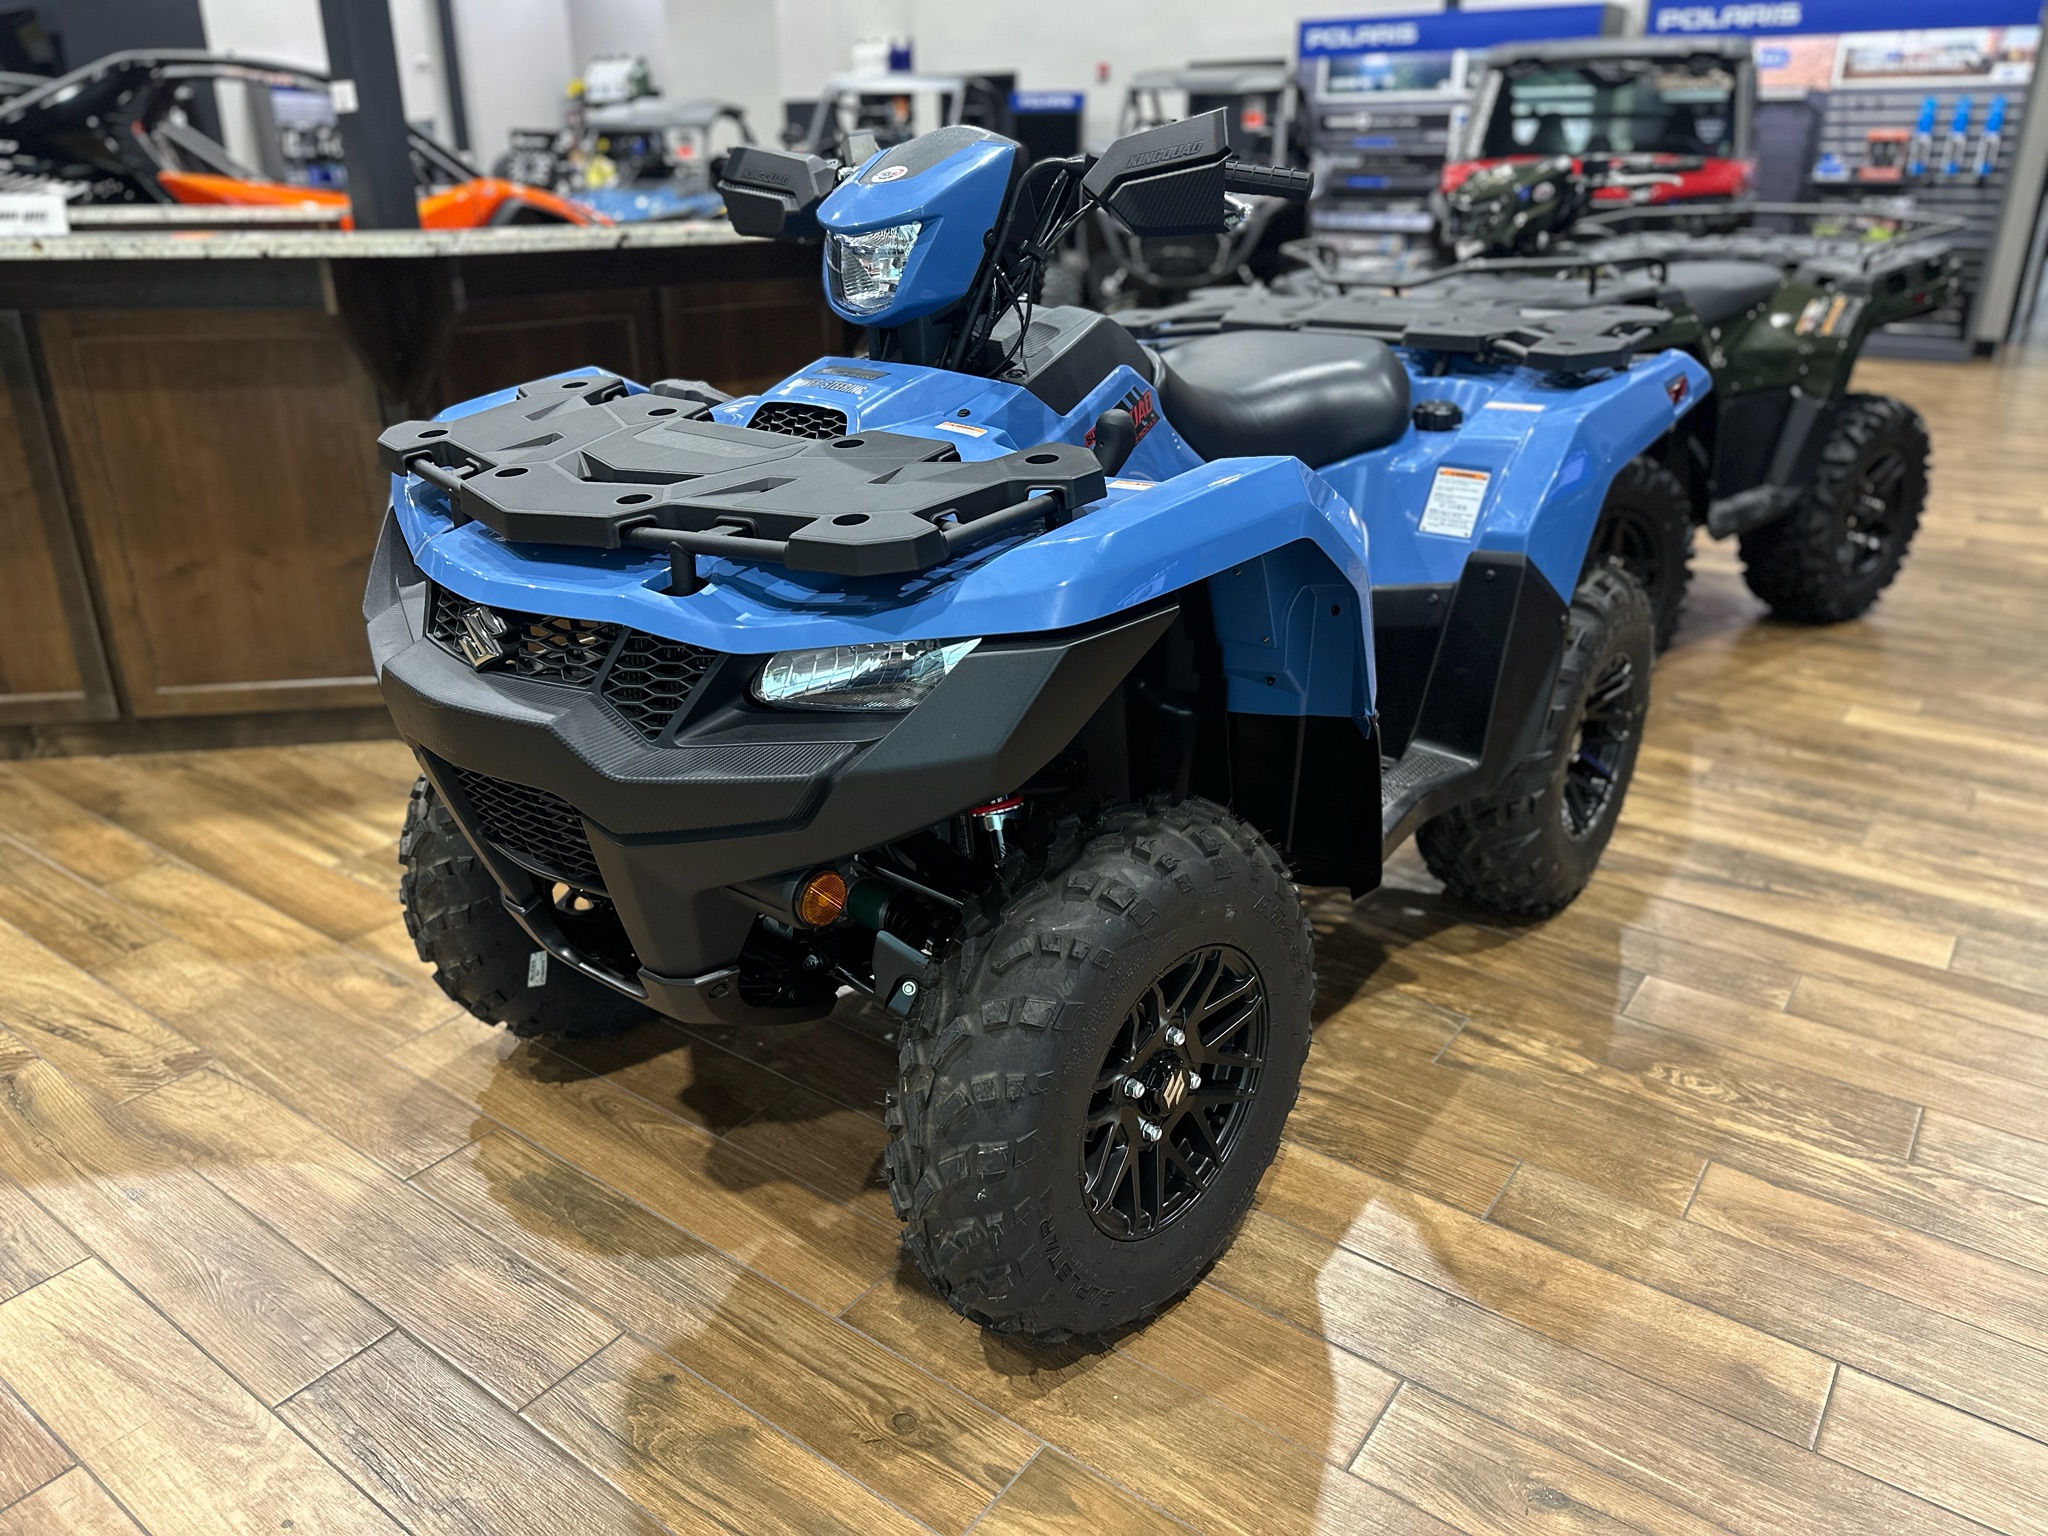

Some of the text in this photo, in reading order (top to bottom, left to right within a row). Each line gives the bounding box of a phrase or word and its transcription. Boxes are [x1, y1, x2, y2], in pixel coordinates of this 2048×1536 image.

[1656, 3, 1802, 32] POLARIS
[1305, 22, 1418, 50] POLARIS
[1126, 140, 1205, 169] KINGQUAD
[742, 169, 790, 186] KINGQUAD
[1039, 1213, 1116, 1307] CARLSTAR
